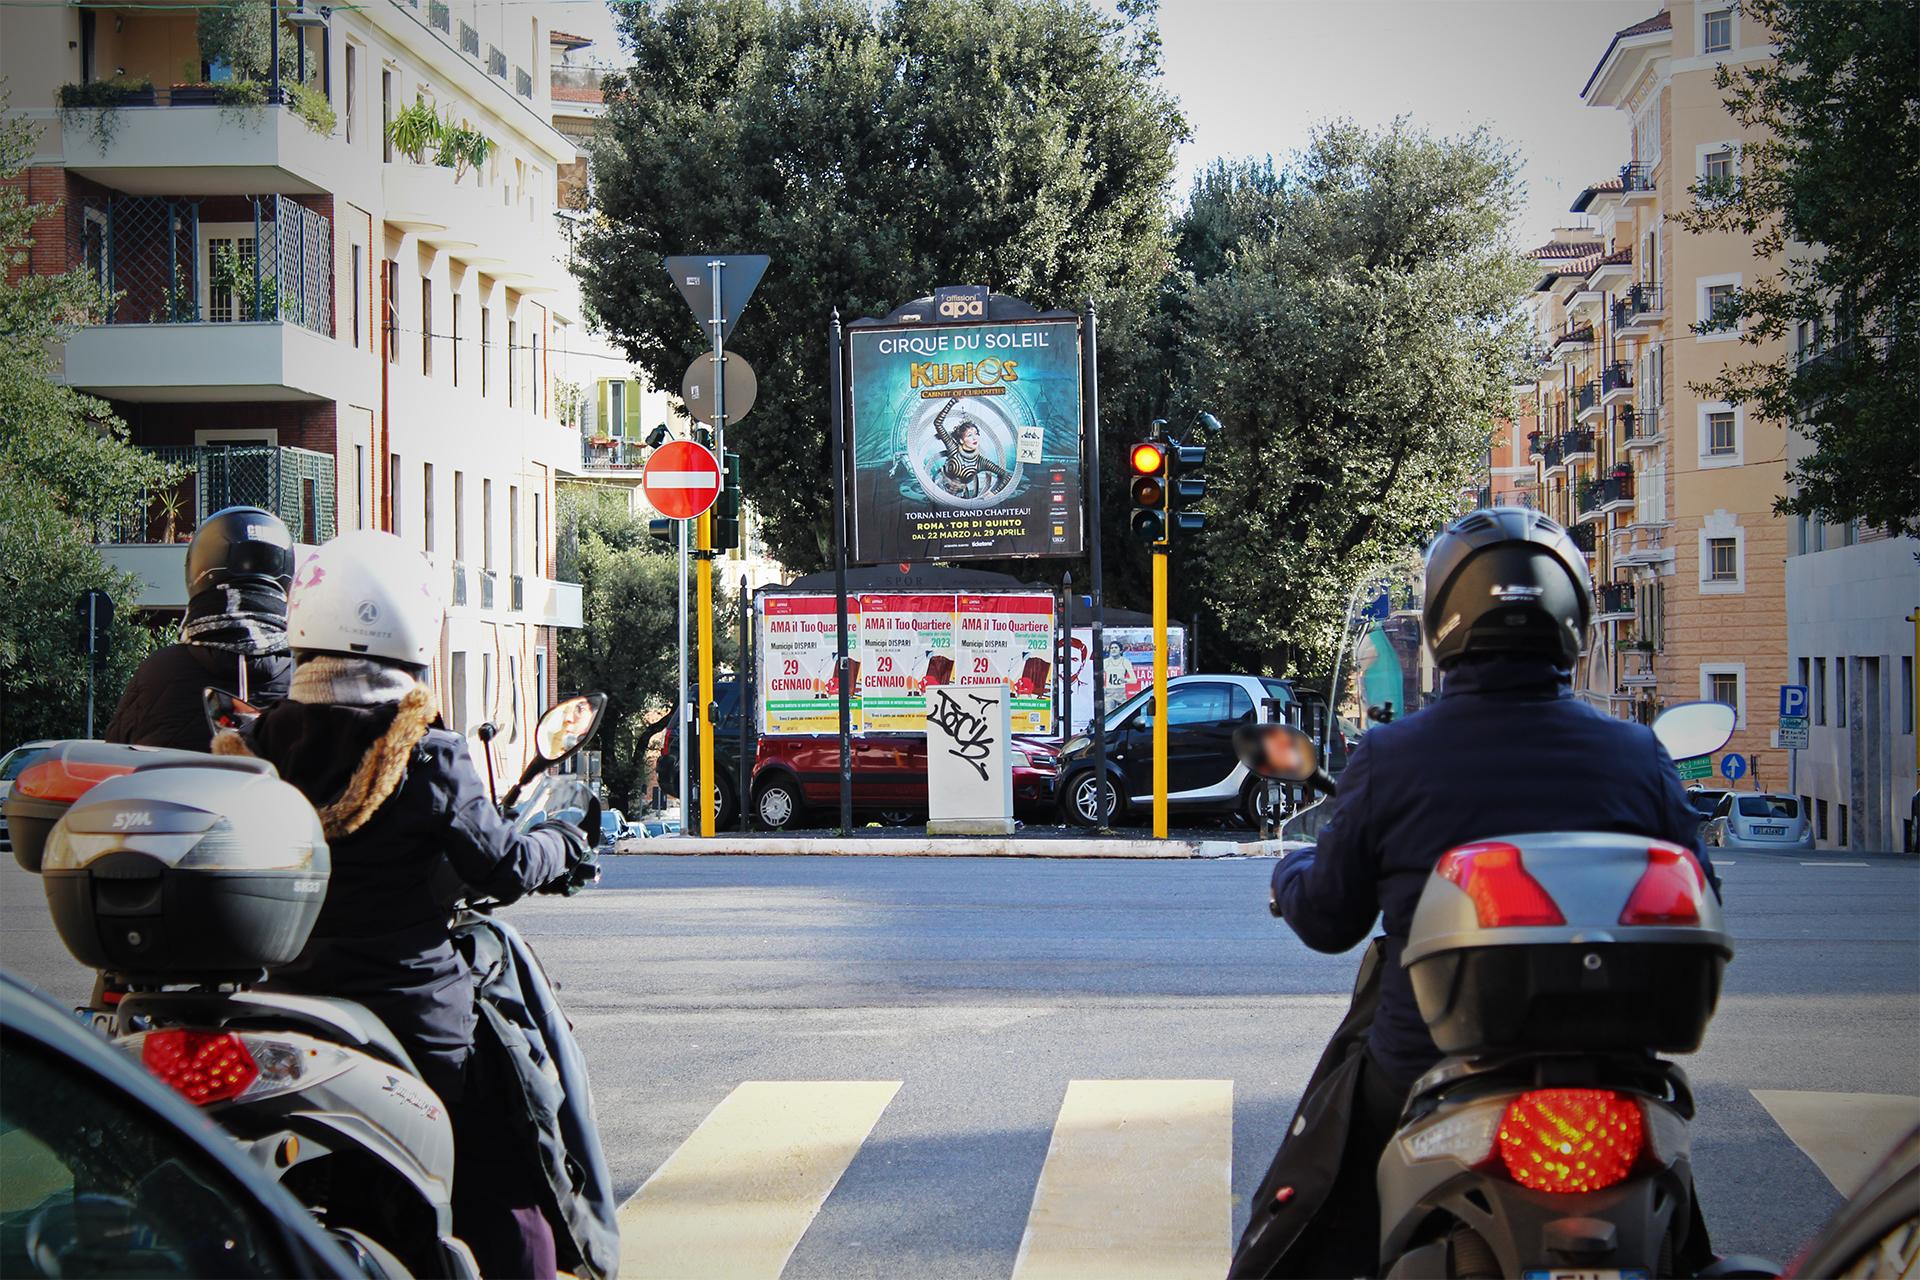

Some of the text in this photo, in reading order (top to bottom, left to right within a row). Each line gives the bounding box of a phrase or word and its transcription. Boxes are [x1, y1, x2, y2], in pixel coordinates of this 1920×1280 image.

[940, 301, 982, 318] apa
[879, 333, 1049, 356] CIRQUE DU SOLEIL
[905, 512, 934, 520] TORNA
[953, 510, 983, 518] GRAND
[917, 523, 944, 531] ROMA
[950, 521, 969, 529] TOR
[984, 519, 1022, 527] QUINTO
[940, 531, 970, 539] MARZO
[996, 528, 1025, 536] APRILE
[771, 621, 856, 633] AMA il Tuo Quarre
[865, 618, 951, 631] AMA il Tuo Quartiere
[962, 618, 1048, 632] AMA il Tuo Quartiere
[931, 638, 950, 648] 2023
[961, 640, 983, 648] Municipi
[1028, 640, 1047, 649] 2023
[784, 660, 799, 675] 29
[878, 657, 892, 672] 29
[974, 658, 988, 673] 29
[772, 679, 811, 691] GENNAIO
[865, 676, 905, 688] GENNAIO
[1786, 689, 1804, 714] P
[112, 812, 152, 830] SYM
